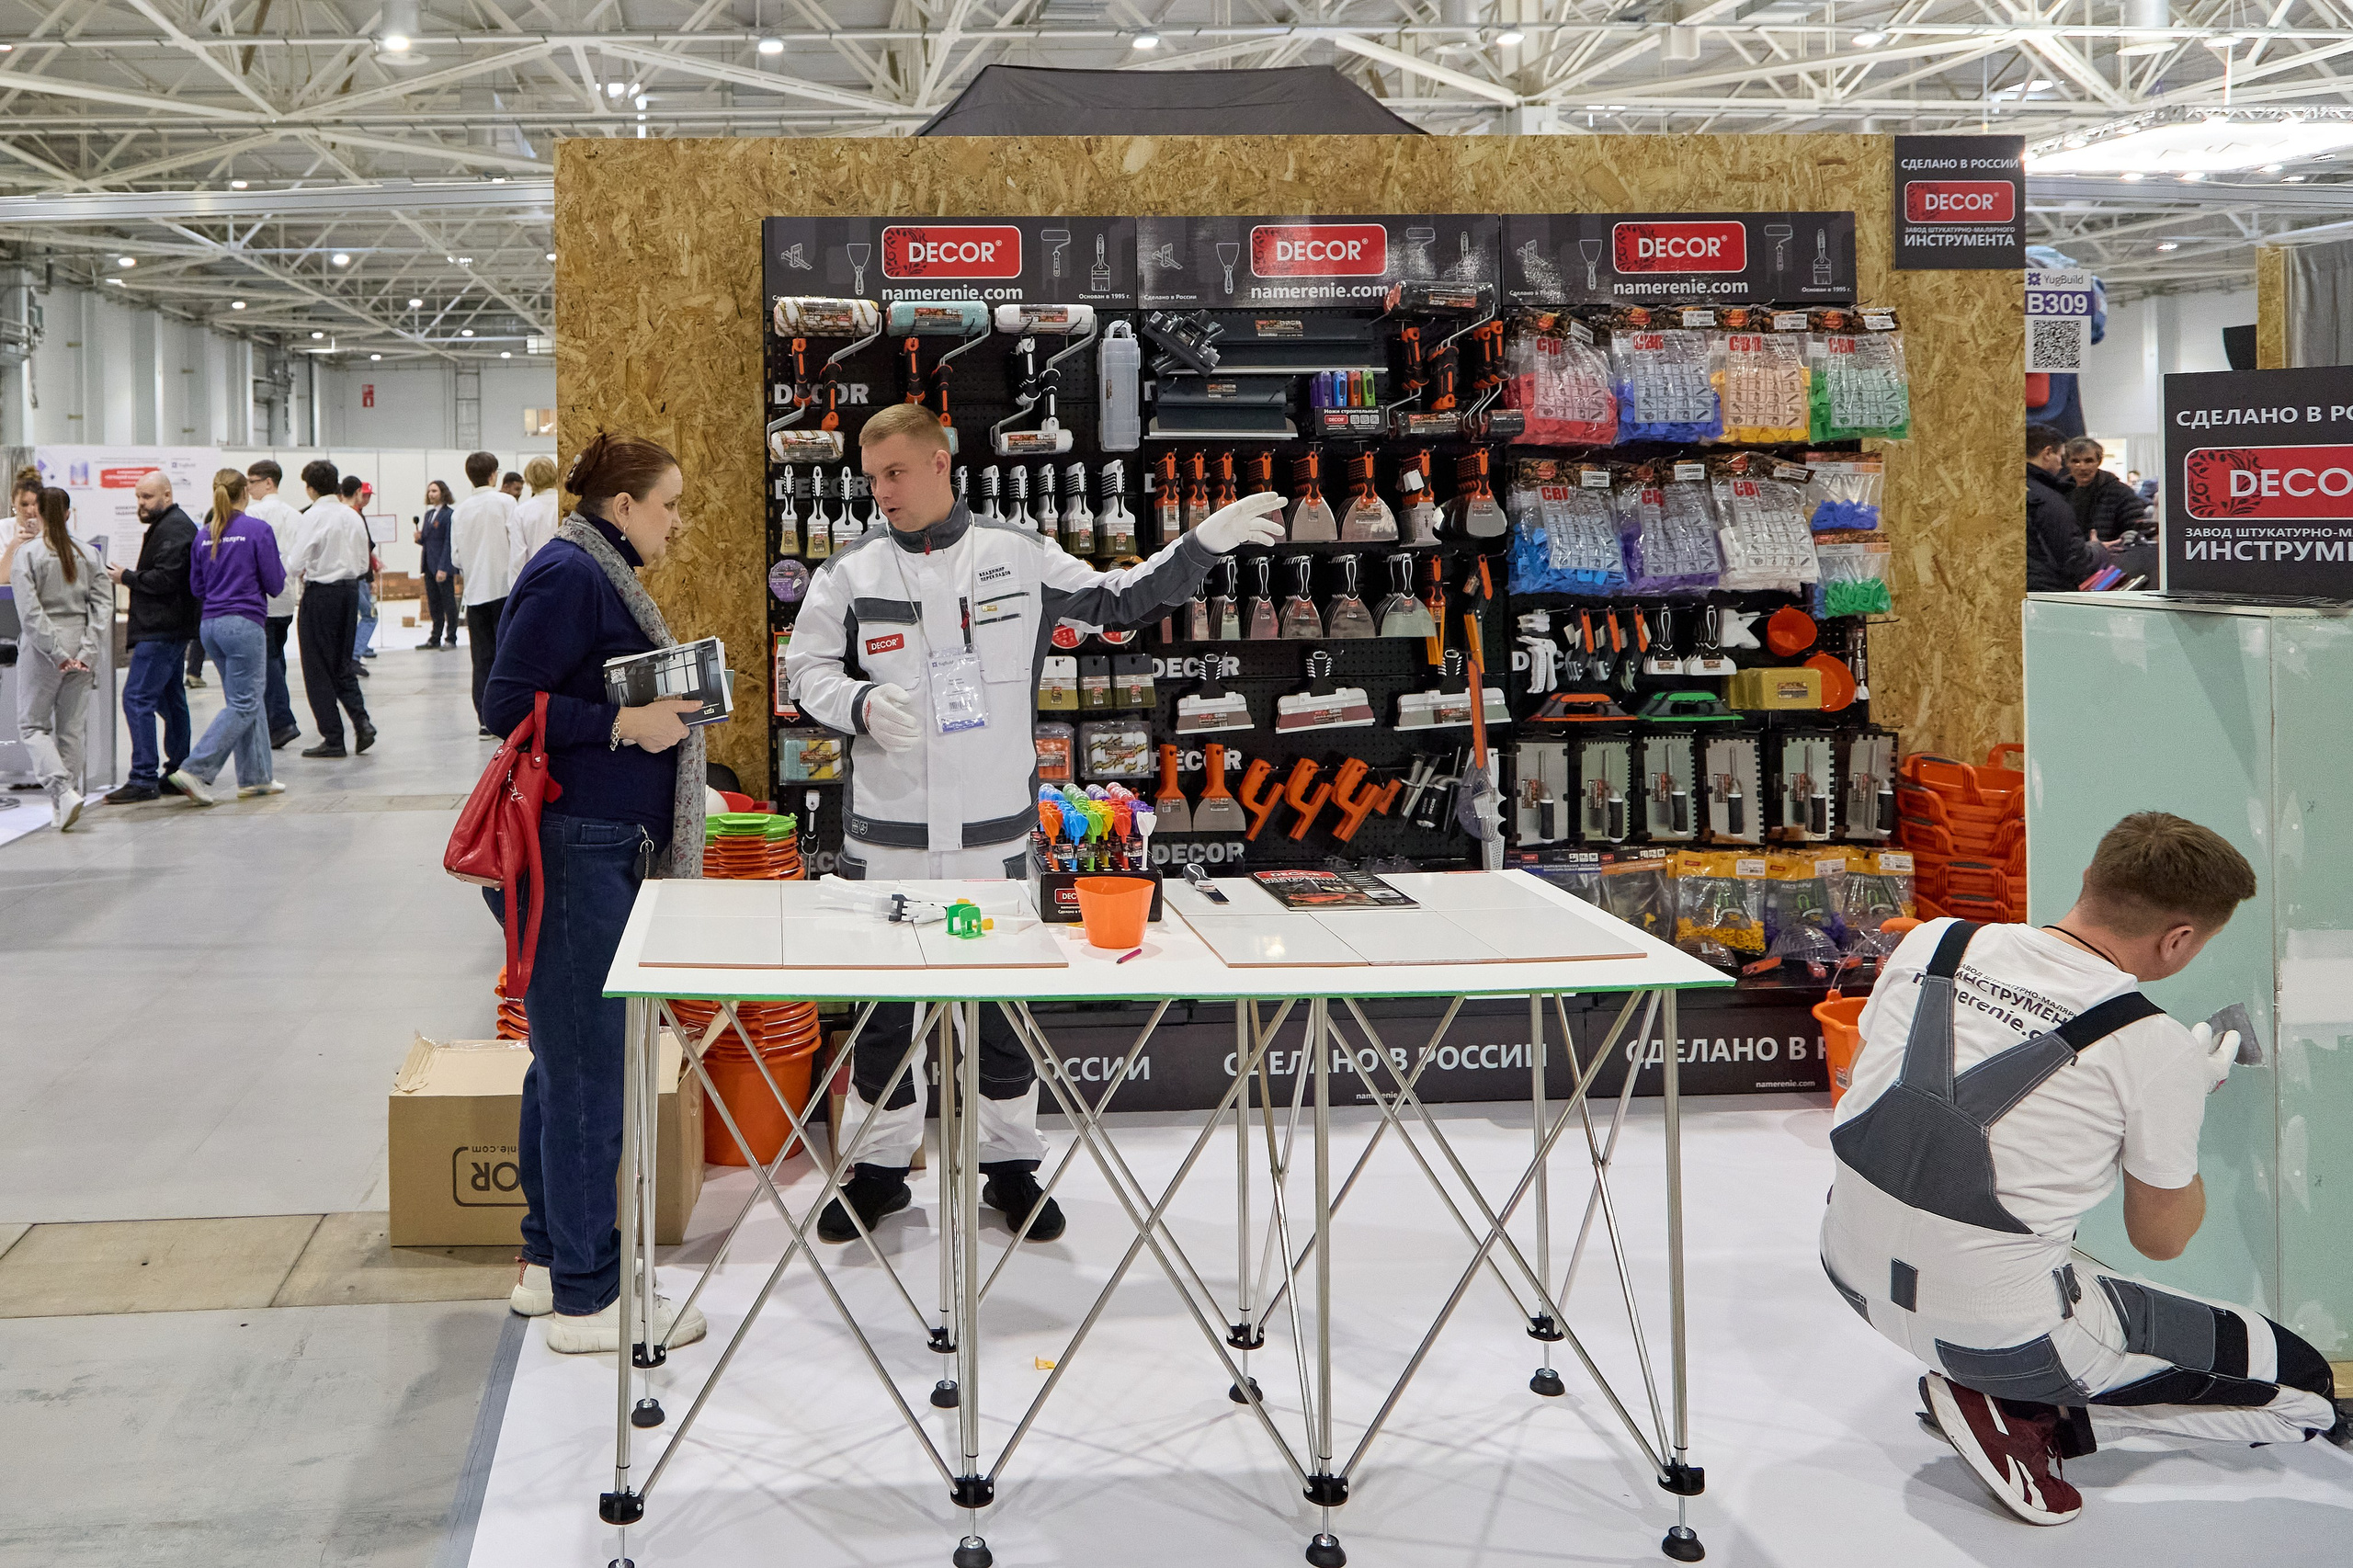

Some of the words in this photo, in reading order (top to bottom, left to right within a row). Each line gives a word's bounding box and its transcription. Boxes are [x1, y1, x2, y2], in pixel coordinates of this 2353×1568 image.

[1901, 158, 1957, 170] СДЕЛАНО
[1961, 159, 1968, 169] В
[1971, 159, 2018, 169] РОССИИ
[1904, 234, 2016, 246] ИНСТРУМЕНТА
[1613, 278, 1749, 296] namerenie.com
[2043, 275, 2084, 286] YugBuild
[881, 284, 1023, 301] namerenie.com
[1250, 282, 1389, 300] namerenie.com
[2028, 293, 2088, 314] B309
[2176, 406, 2299, 429] СДЕЛАНО
[2306, 406, 2323, 423] В
[2185, 528, 2233, 539] ЗАВОД
[2236, 528, 2353, 538] ШТУКАТУРНО-М
[2185, 540, 2353, 562] ИНСТРУМ
[1153, 656, 1240, 678] DECR
[1152, 842, 1245, 865] DECOR
[1960, 963, 1983, 978] АВОД
[1789, 1036, 1807, 1060] В
[1039, 1056, 1150, 1082] ОССИИ
[1756, 1079, 1816, 1088] namerenie.com
[472, 1145, 517, 1154] nie.com
